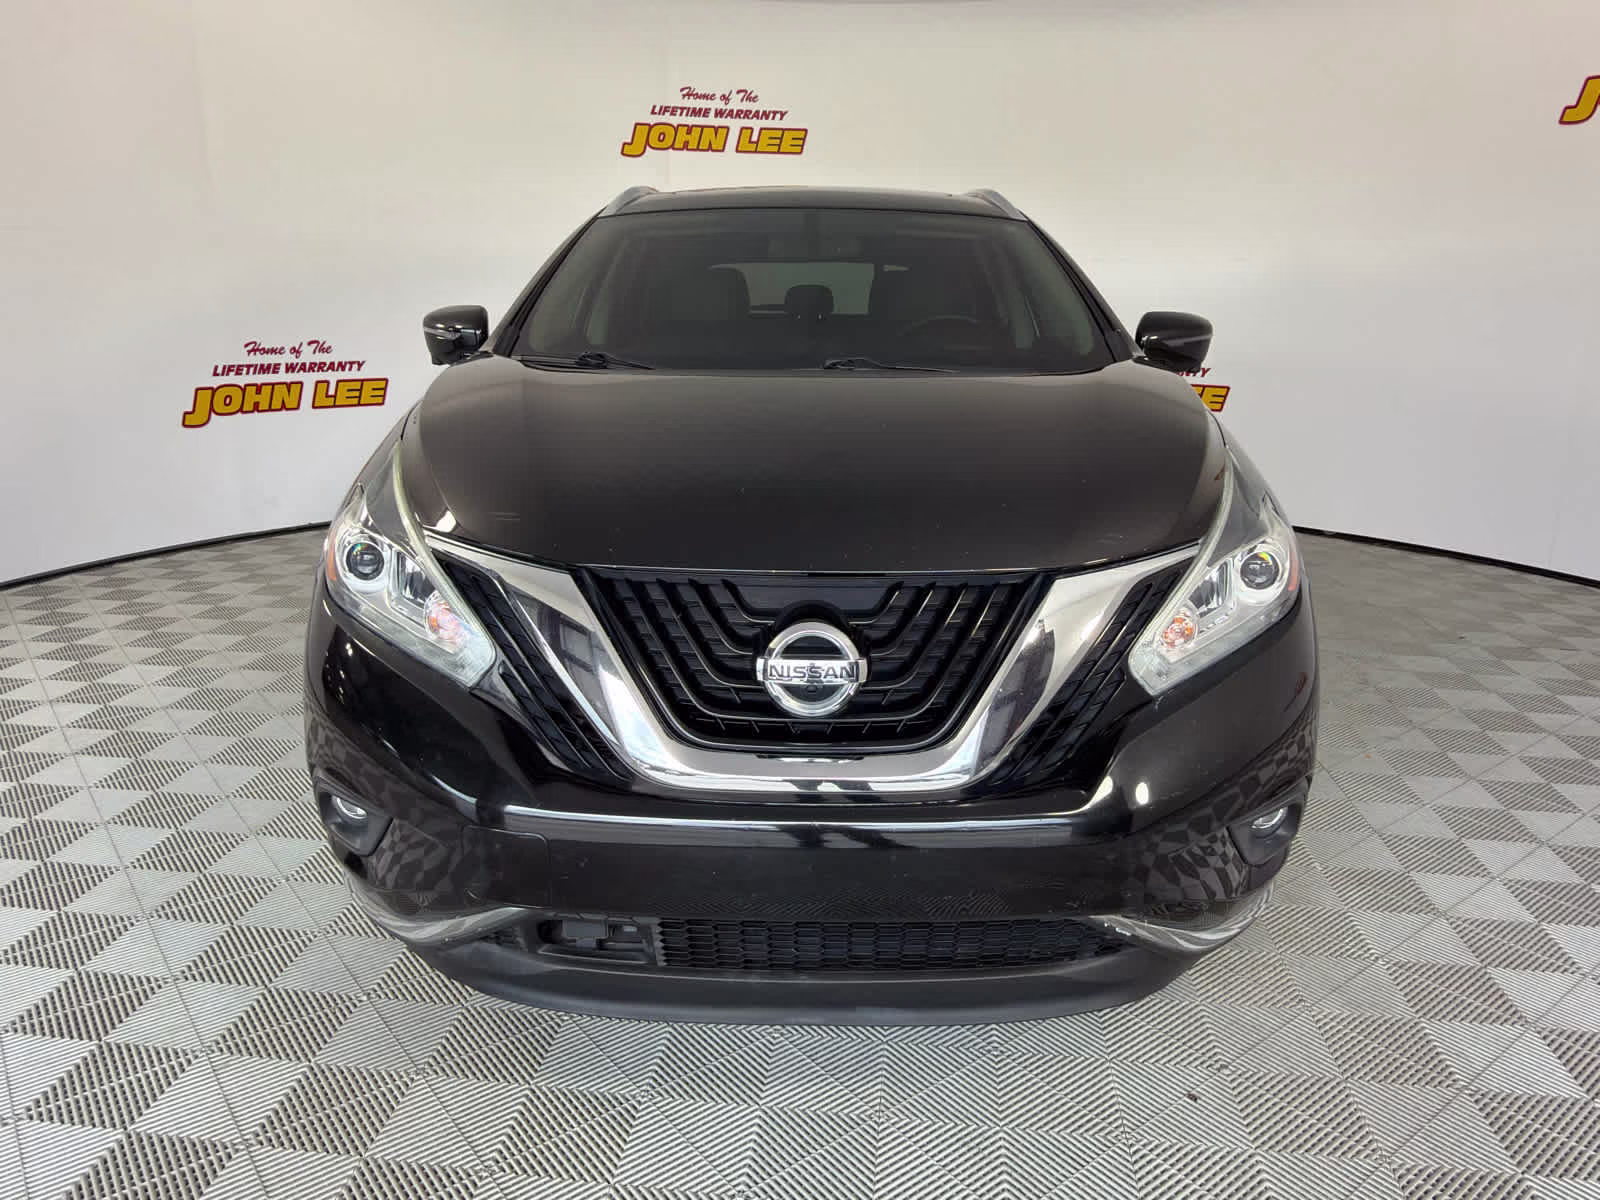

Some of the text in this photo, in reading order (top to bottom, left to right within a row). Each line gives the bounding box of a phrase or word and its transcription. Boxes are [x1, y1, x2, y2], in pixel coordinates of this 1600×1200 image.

[680, 86, 760, 105] Home of The
[650, 105, 788, 121] LIFETIME WARRANTY
[621, 122, 808, 157] JOHN LEE
[244, 339, 333, 359] Home of The
[212, 360, 366, 377] LIFETIME WARRANTY
[182, 378, 389, 428] JOHN LEE
[769, 664, 856, 679] NISSAN
